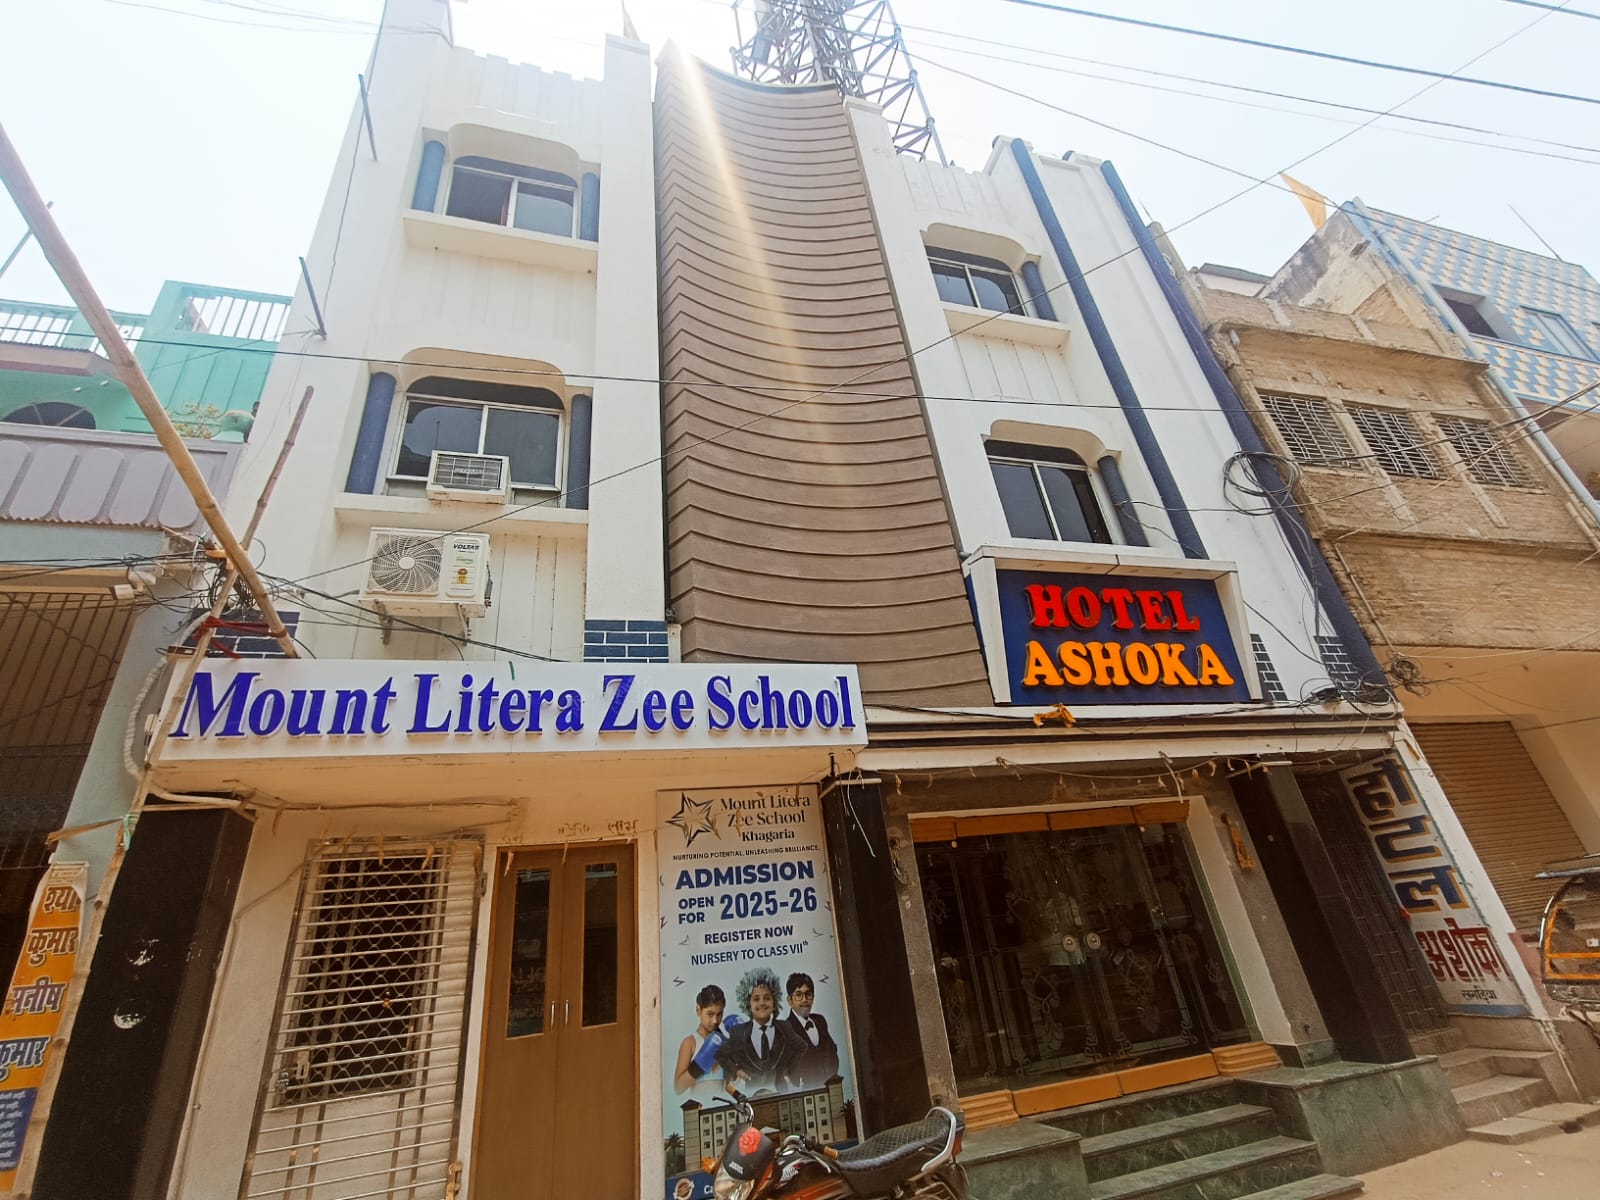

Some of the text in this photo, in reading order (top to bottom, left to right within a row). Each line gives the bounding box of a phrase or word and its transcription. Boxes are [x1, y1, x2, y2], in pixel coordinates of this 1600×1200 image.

[1025, 583, 1200, 631] HOTEL
[1022, 640, 1235, 687] ASHOKA
[168, 671, 856, 738] Mount Litera Zee School
[720, 796, 766, 811] Mount
[727, 809, 806, 828] Ze School
[742, 829, 795, 843] Khagaria
[672, 852, 709, 861] NURTURING
[675, 860, 815, 890] ADMISSION
[678, 886, 817, 920] OPEN 2025-26
[678, 911, 705, 924] FOR
[704, 925, 794, 945] REGISTER NOW
[28, 927, 80, 966] कुमार
[691, 950, 739, 966] NURSERY
[741, 948, 755, 960] TO
[757, 945, 788, 959] CLASS
